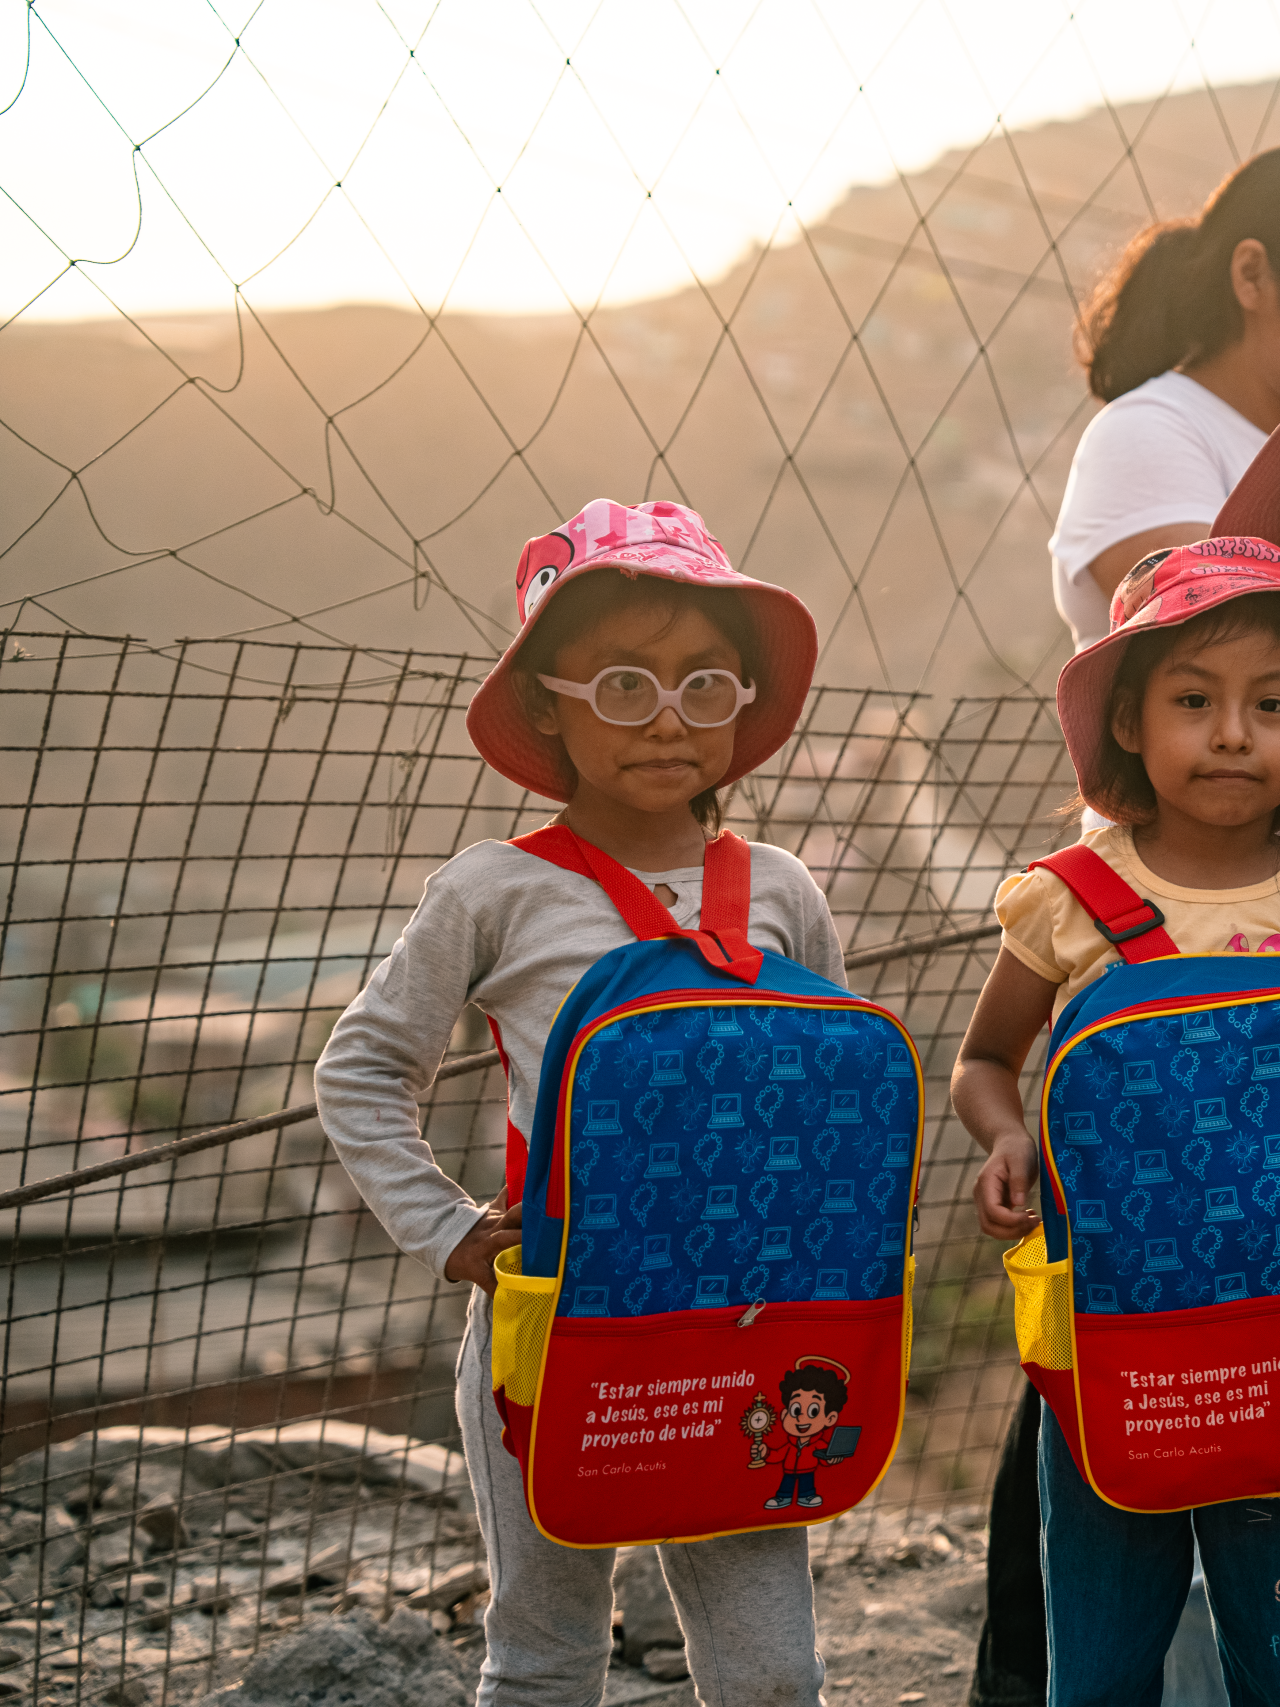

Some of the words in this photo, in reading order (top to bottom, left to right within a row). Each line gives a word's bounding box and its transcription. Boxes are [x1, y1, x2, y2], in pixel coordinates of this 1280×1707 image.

[647, 1377, 707, 1397] siempre
[711, 1369, 755, 1390] unido
[1181, 1365, 1247, 1386] siempre
[1123, 1398, 1134, 1411] a
[1138, 1391, 1190, 1410] Jesús,
[1194, 1391, 1221, 1406] ese
[1226, 1388, 1244, 1402] es
[1248, 1379, 1269, 1398] mi
[585, 1410, 597, 1424] a
[601, 1403, 649, 1424] Jesús,
[653, 1403, 679, 1419] ese
[682, 1401, 699, 1416] es
[702, 1396, 724, 1414] mi
[1125, 1415, 1201, 1436] proyecto
[1206, 1409, 1225, 1427] de
[581, 1427, 655, 1451] proyecto
[658, 1423, 677, 1442] de
[1128, 1450, 1149, 1460] San
[1153, 1446, 1185, 1459] Carlo
[1189, 1443, 1222, 1455] Acutis
[577, 1466, 598, 1477] San
[602, 1463, 631, 1475] Carlo
[635, 1460, 667, 1472] Acutis
